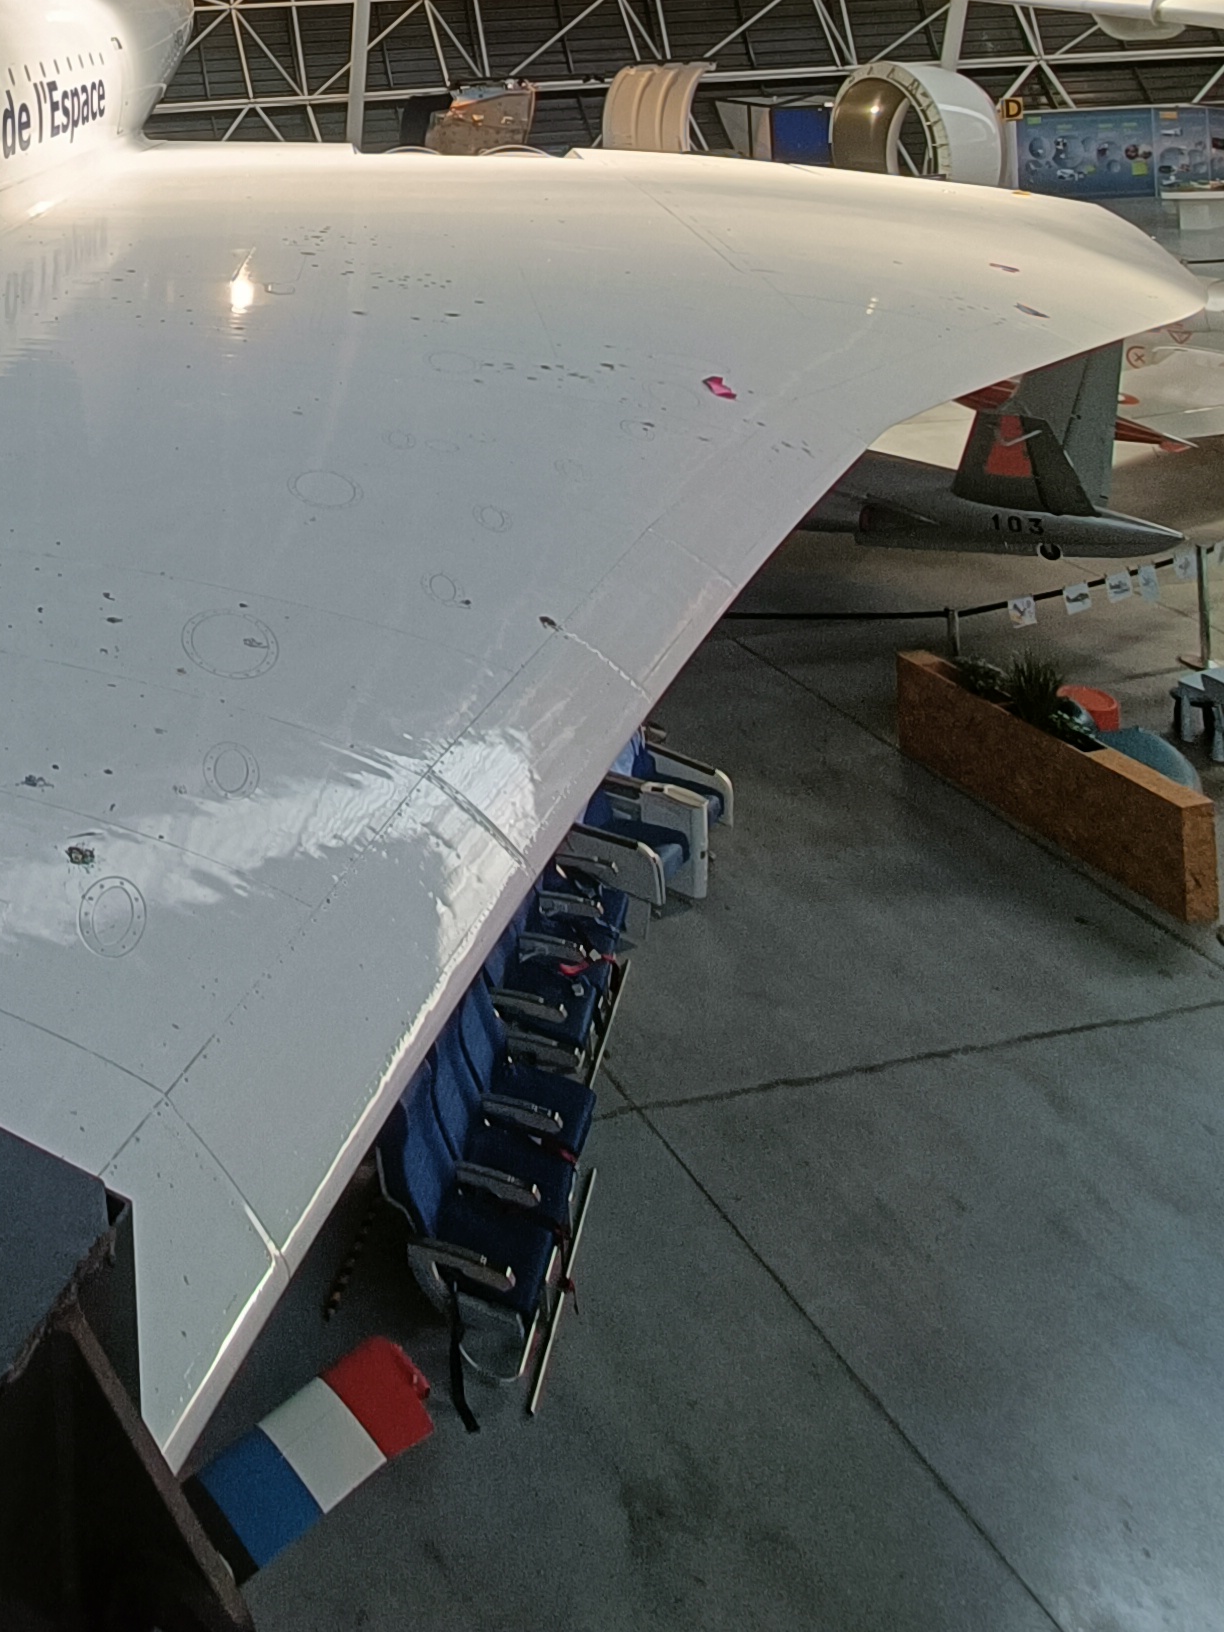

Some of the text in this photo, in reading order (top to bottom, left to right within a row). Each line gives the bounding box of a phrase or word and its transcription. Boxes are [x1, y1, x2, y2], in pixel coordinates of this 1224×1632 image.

[1005, 99, 1022, 118] D
[2, 89, 32, 160] de
[32, 79, 106, 144] l'Espace
[992, 513, 1044, 534] 103
